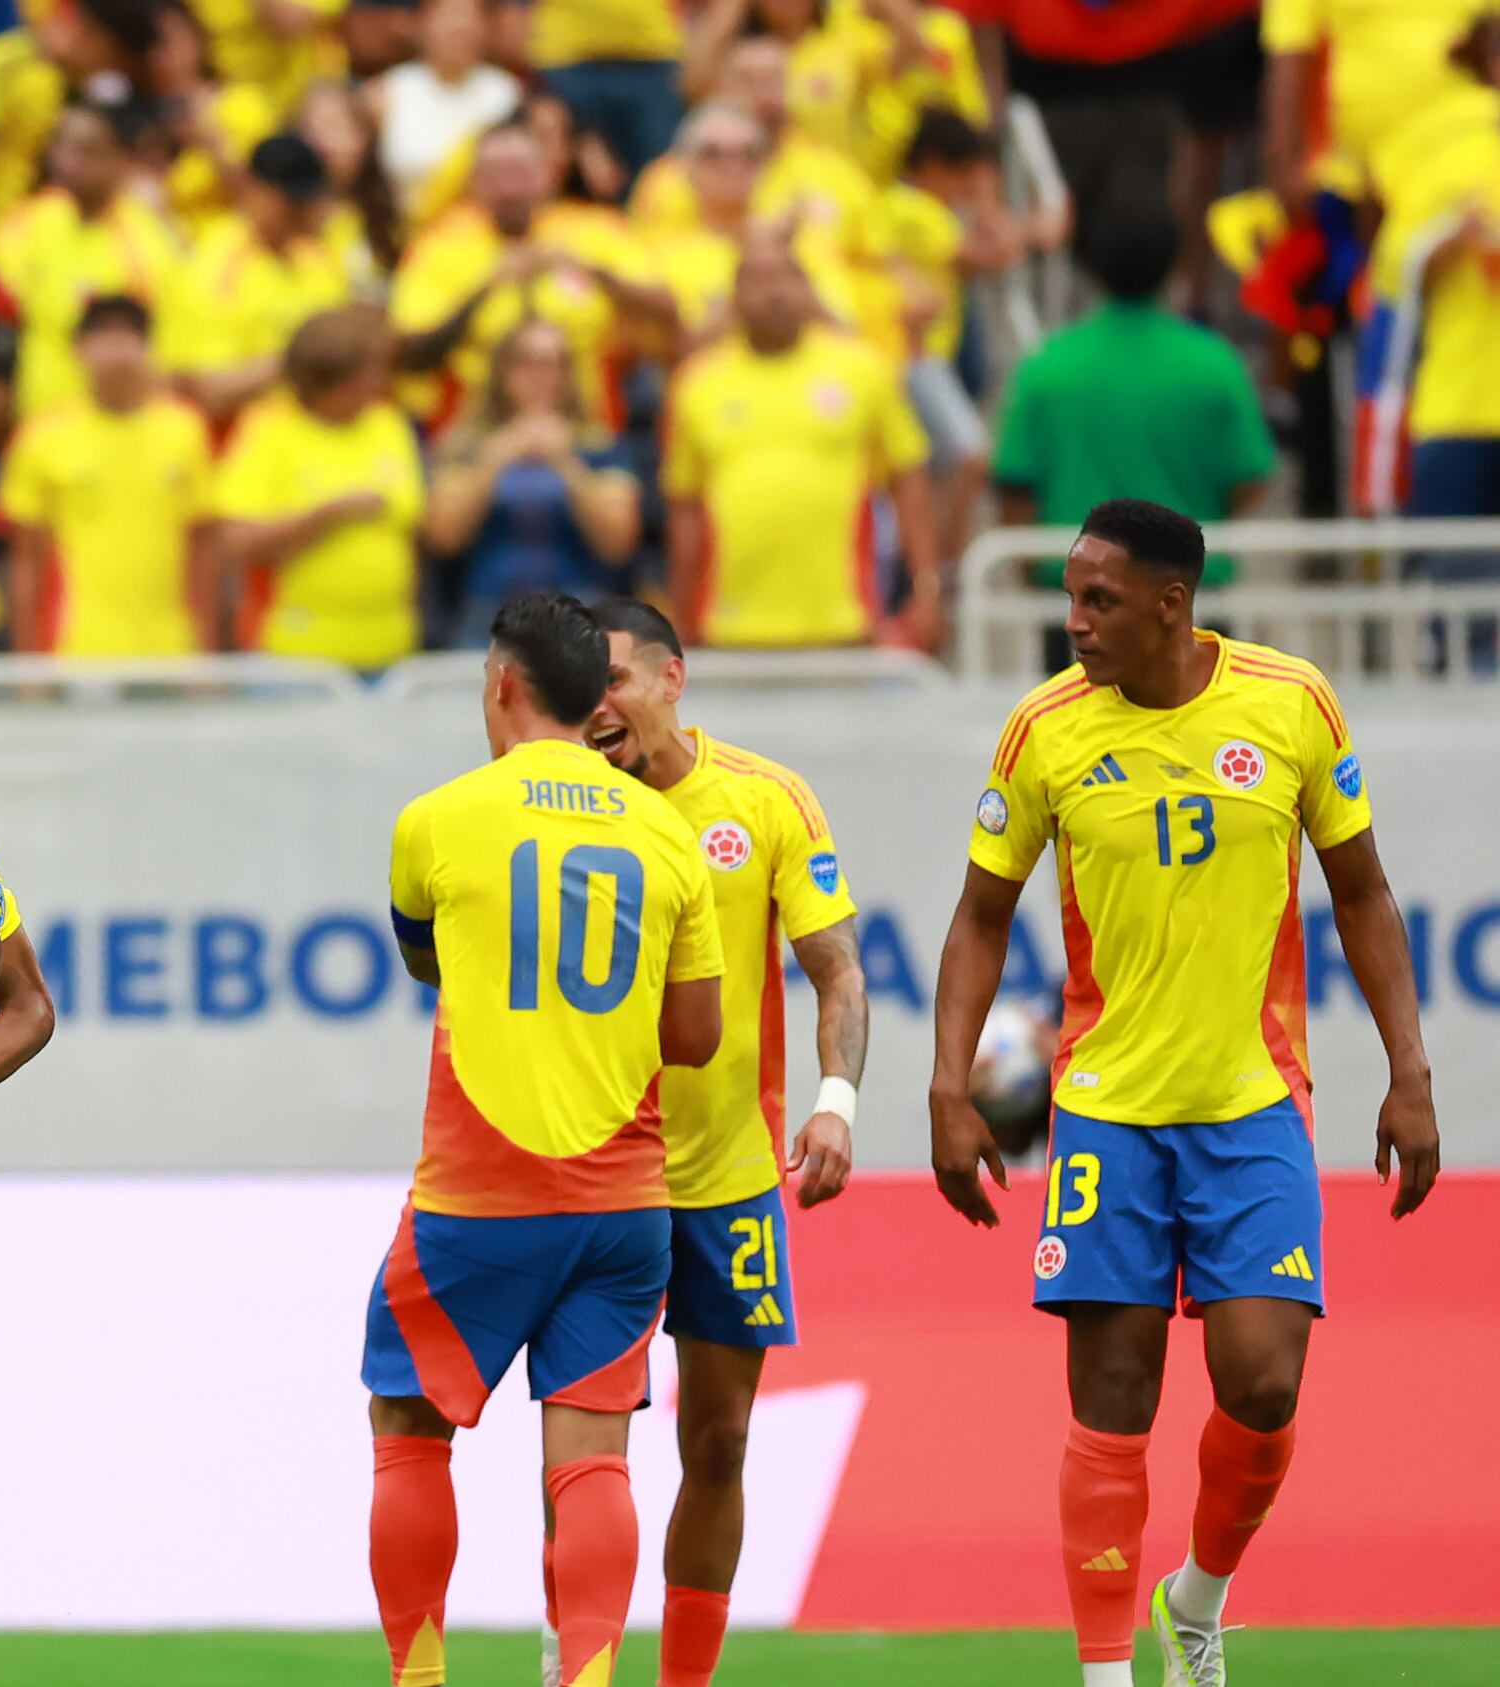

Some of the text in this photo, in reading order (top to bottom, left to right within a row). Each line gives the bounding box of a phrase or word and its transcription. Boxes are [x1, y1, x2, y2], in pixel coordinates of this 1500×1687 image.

[520, 779, 625, 815] JAMES
[1155, 794, 1216, 867] 13
[508, 838, 644, 1015] 10
[1046, 1152, 1101, 1229] 13
[729, 1213, 777, 1291] 21
